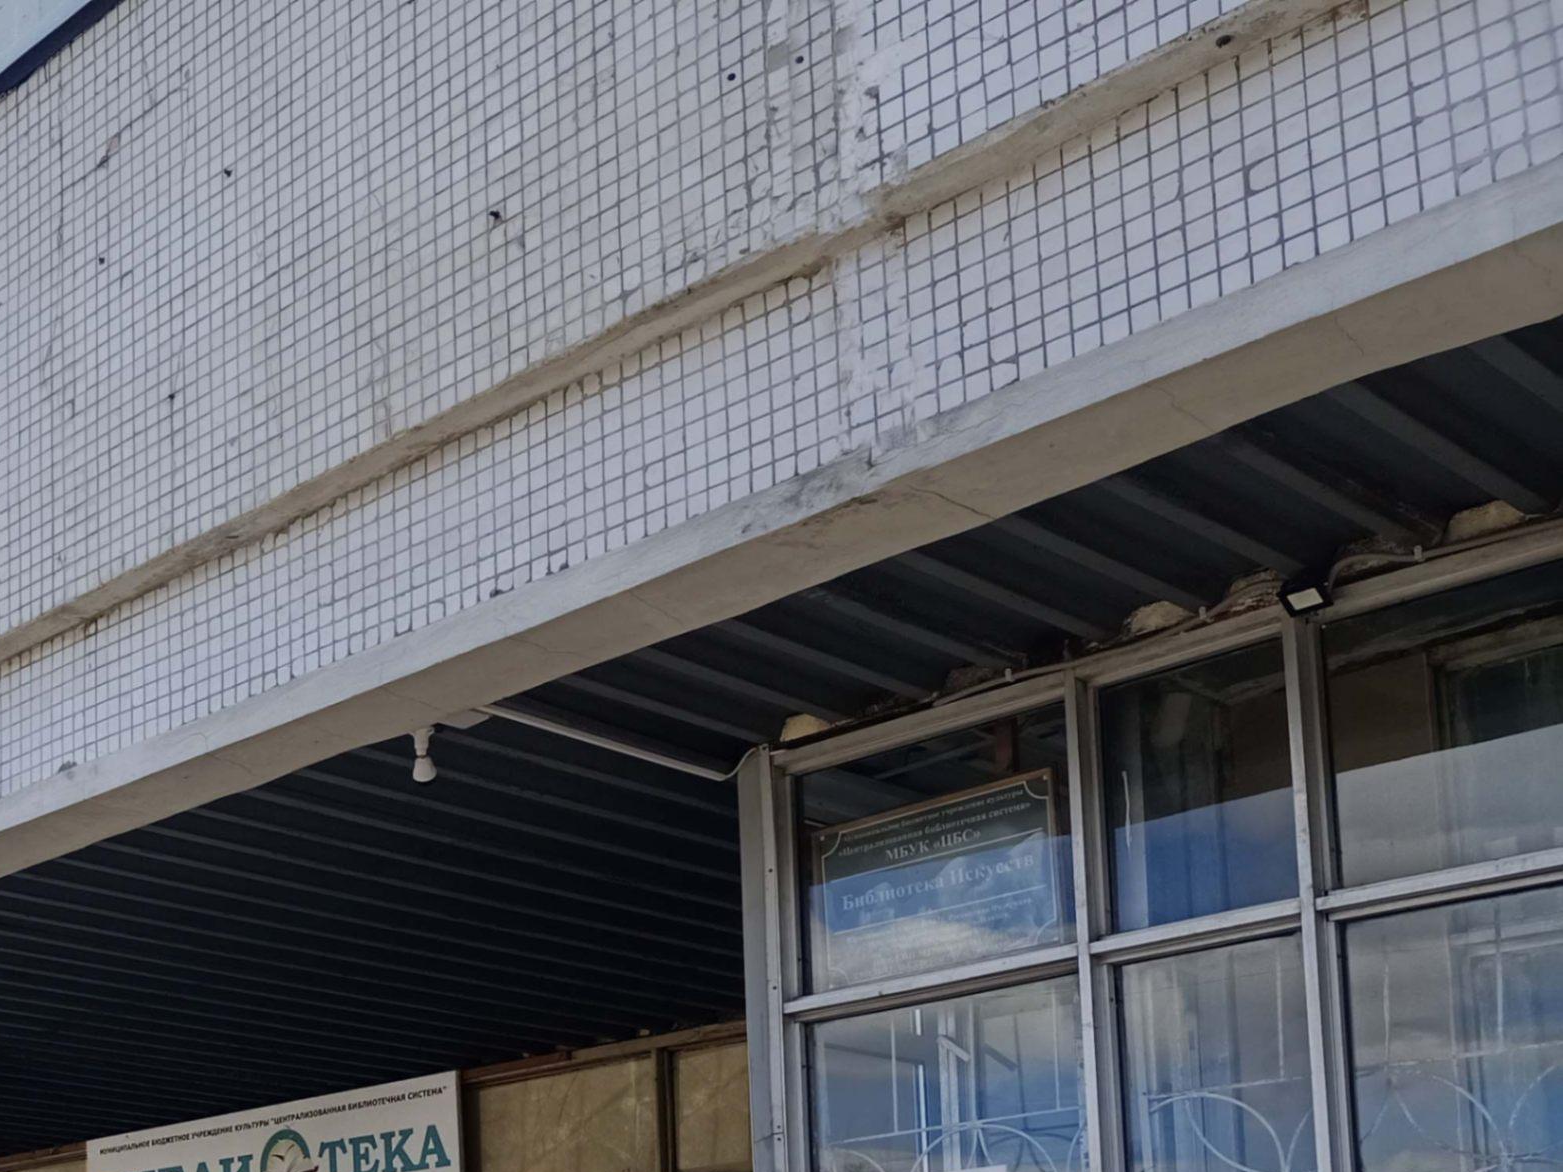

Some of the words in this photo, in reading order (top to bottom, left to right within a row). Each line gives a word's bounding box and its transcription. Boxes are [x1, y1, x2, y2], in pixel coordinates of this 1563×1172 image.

[885, 839, 930, 861] МБУК
[933, 828, 982, 849] «ЦБС»
[842, 877, 944, 911] Библиотека
[949, 854, 1035, 885] Искусств
[99, 1140, 150, 1155] МУНИЦИПАЛЬНОЕ
[151, 1133, 190, 1147] БЮДЖЕТНОЕ
[191, 1125, 233, 1140] УЧРЕЖДЕНИЕ
[234, 1118, 270, 1132] КУЛЬТУРЫ
[271, 1104, 347, 1126] "ЦЕНТРАЛИЗОВАННАЯ
[348, 1094, 406, 1111] БИБЛИОТЕЧНАЯ
[407, 1085, 448, 1100] СИСТЕМА"
